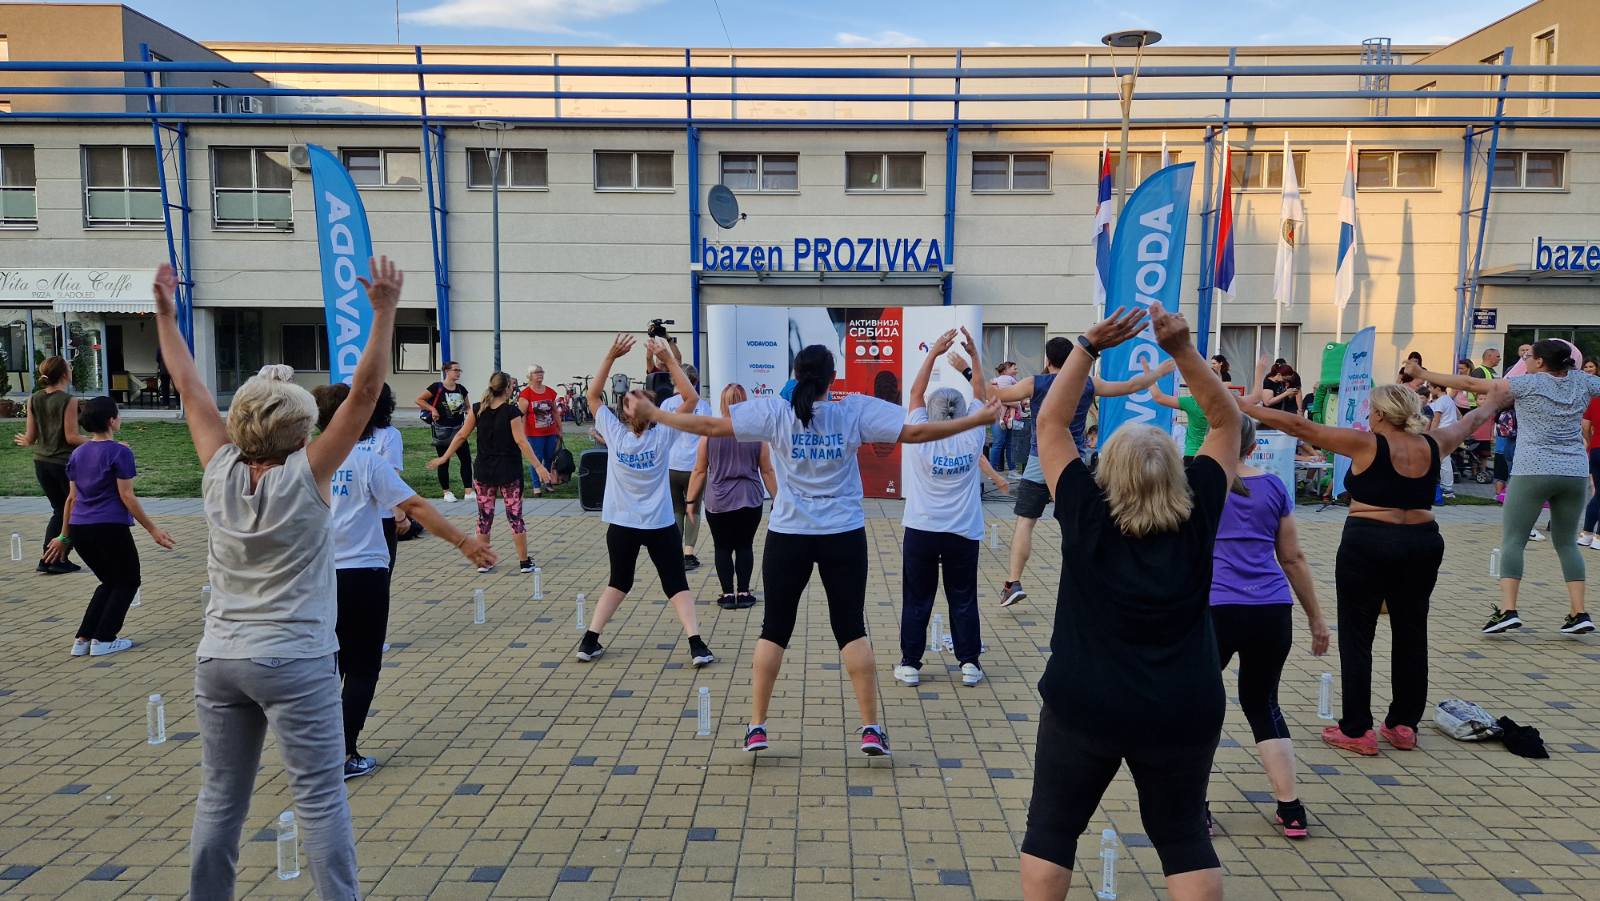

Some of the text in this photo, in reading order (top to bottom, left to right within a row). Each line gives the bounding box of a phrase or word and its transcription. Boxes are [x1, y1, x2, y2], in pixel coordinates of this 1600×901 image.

[702, 237, 944, 272] bazen PROZIVKA
[1537, 236, 1600, 270] baze
[0, 271, 29, 291] Vita
[36, 271, 80, 291] Mia
[849, 319, 899, 327] АКТИВНИЈА
[849, 327, 899, 337] СРБИЈА
[791, 431, 844, 447] VEŽBAJTE
[791, 448, 842, 460] SA NAMA
[933, 453, 973, 467] VEŽBAJTE
[932, 464, 970, 475] SA NAMA
